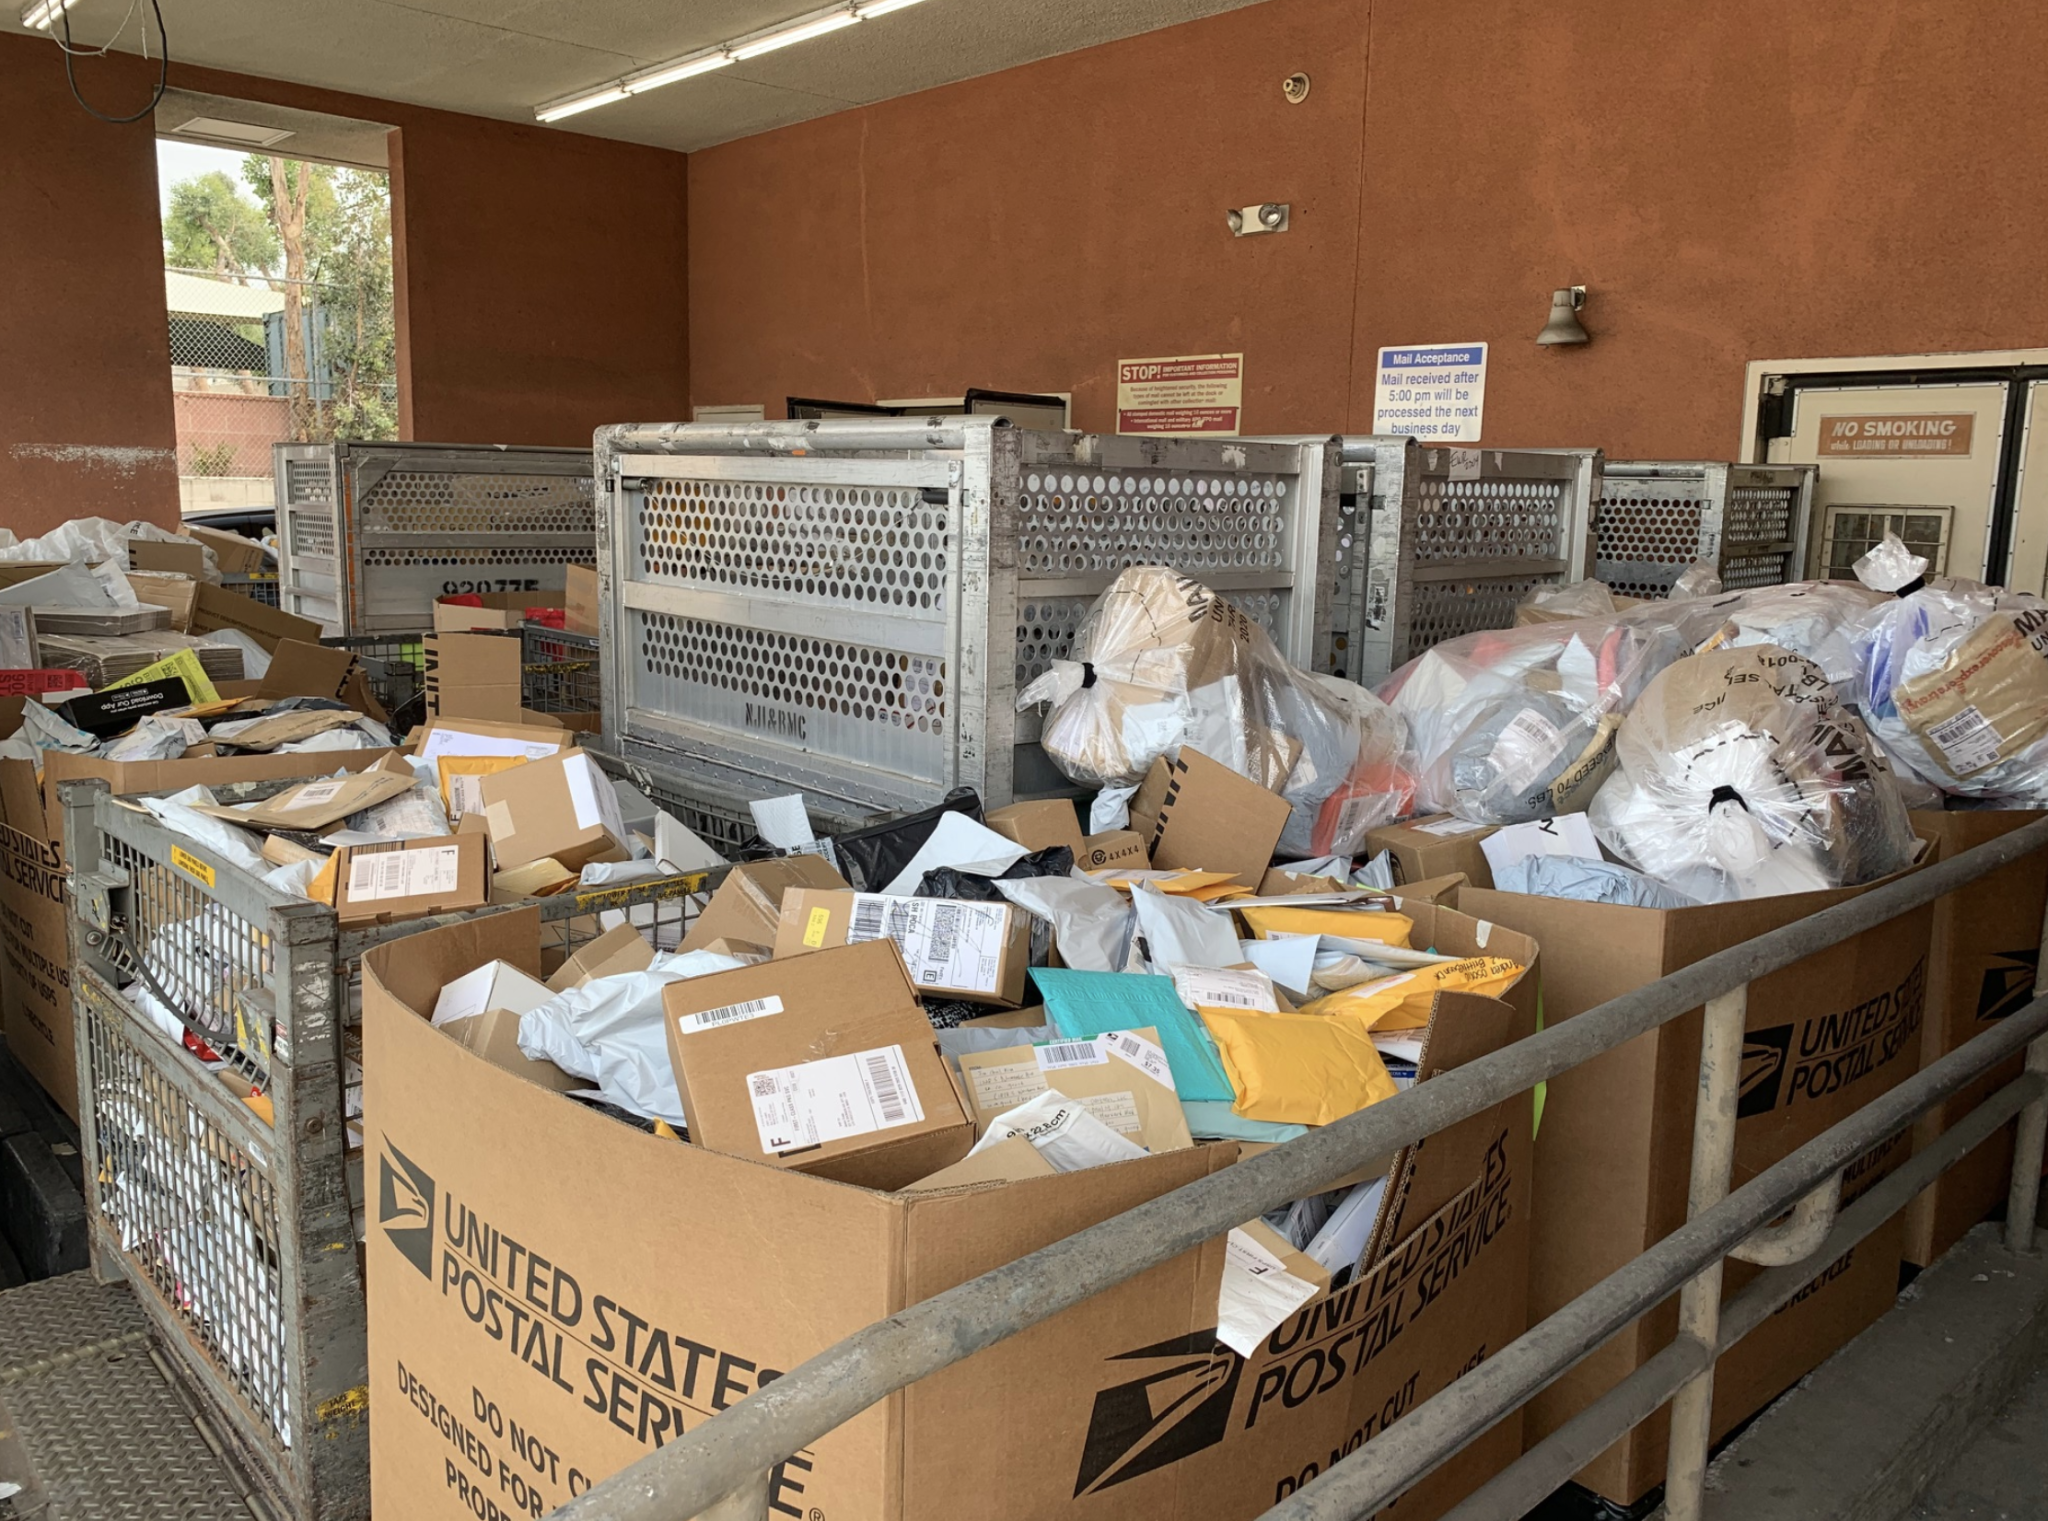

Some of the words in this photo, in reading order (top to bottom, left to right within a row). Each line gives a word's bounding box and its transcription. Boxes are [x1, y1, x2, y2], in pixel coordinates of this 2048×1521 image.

[1393, 354, 1412, 365] Mail
[1414, 353, 1470, 366] Acceptance
[1122, 365, 1161, 380] STOP!
[1163, 365, 1195, 373] IMPORTANT
[1196, 362, 1237, 371] INFORMATION
[1382, 373, 1403, 385] Mail
[1405, 372, 1451, 385] received
[1454, 371, 1479, 383] after
[1389, 390, 1412, 402] 5:00
[1414, 391, 1431, 404] pm
[1434, 389, 1452, 401] will
[1455, 389, 1469, 400] be
[1378, 406, 1432, 421] processed
[1435, 406, 1452, 417] the
[1455, 405, 1478, 417] next
[1391, 422, 1438, 434] business
[1441, 422, 1461, 437] day
[1832, 421, 1858, 437] NO
[1863, 420, 1957, 436] SMOKING
[1853, 440, 1886, 450] LOADING
[1888, 440, 1900, 449] OR
[100, 700, 116, 711] App
[117, 698, 130, 708] Our
[131, 692, 164, 705] Download
[1557, 779, 1572, 794] 70
[1800, 992, 1891, 1058] UNITED
[1786, 1039, 1875, 1106] POSTAL
[770, 1137, 791, 1148] F
[445, 1192, 583, 1327] UNITED
[1248, 1266, 1269, 1275] F
[442, 1249, 574, 1394] POSTAL
[1245, 1290, 1405, 1430] POSTAL
[1379, 1370, 1421, 1431] CUT
[397, 1359, 492, 1478] DESIGNED
[498, 1458, 544, 1520] FOR
[472, 1385, 503, 1439] DO
[510, 1418, 560, 1486] NOT
